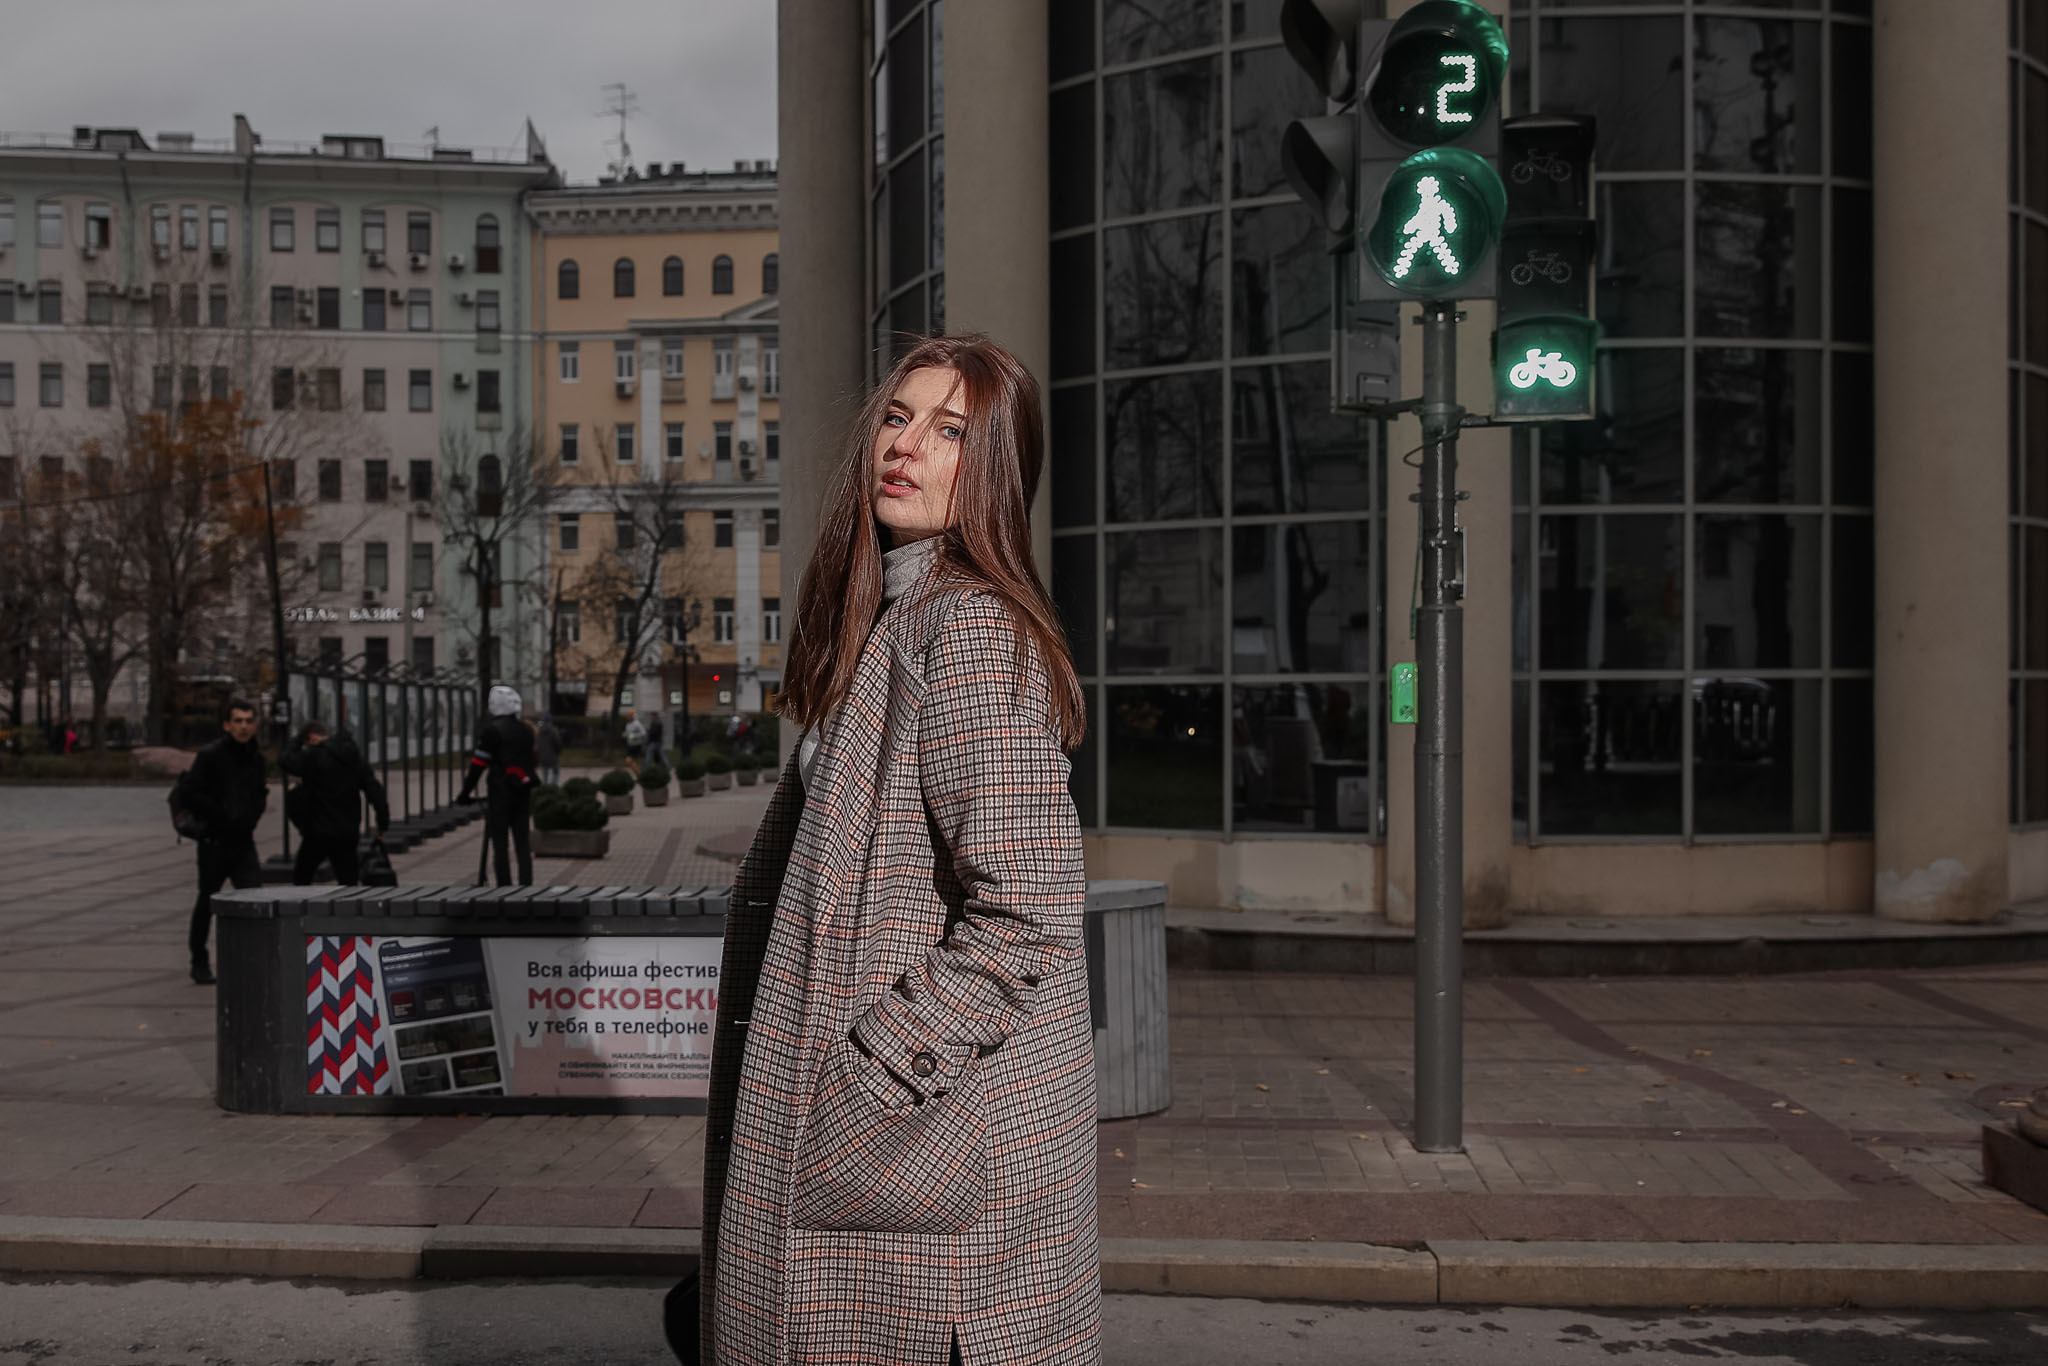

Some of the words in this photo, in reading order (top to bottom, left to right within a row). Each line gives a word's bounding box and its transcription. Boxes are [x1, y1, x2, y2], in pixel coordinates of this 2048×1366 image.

[1436, 54, 1476, 123] 2
[527, 961, 562, 978] Вся
[568, 960, 638, 981] афиша
[644, 960, 718, 981] фестив
[528, 1020, 538, 1037] у
[544, 1017, 588, 1034] тебя
[595, 1021, 605, 1034] в
[612, 1017, 709, 1038] телефоне
